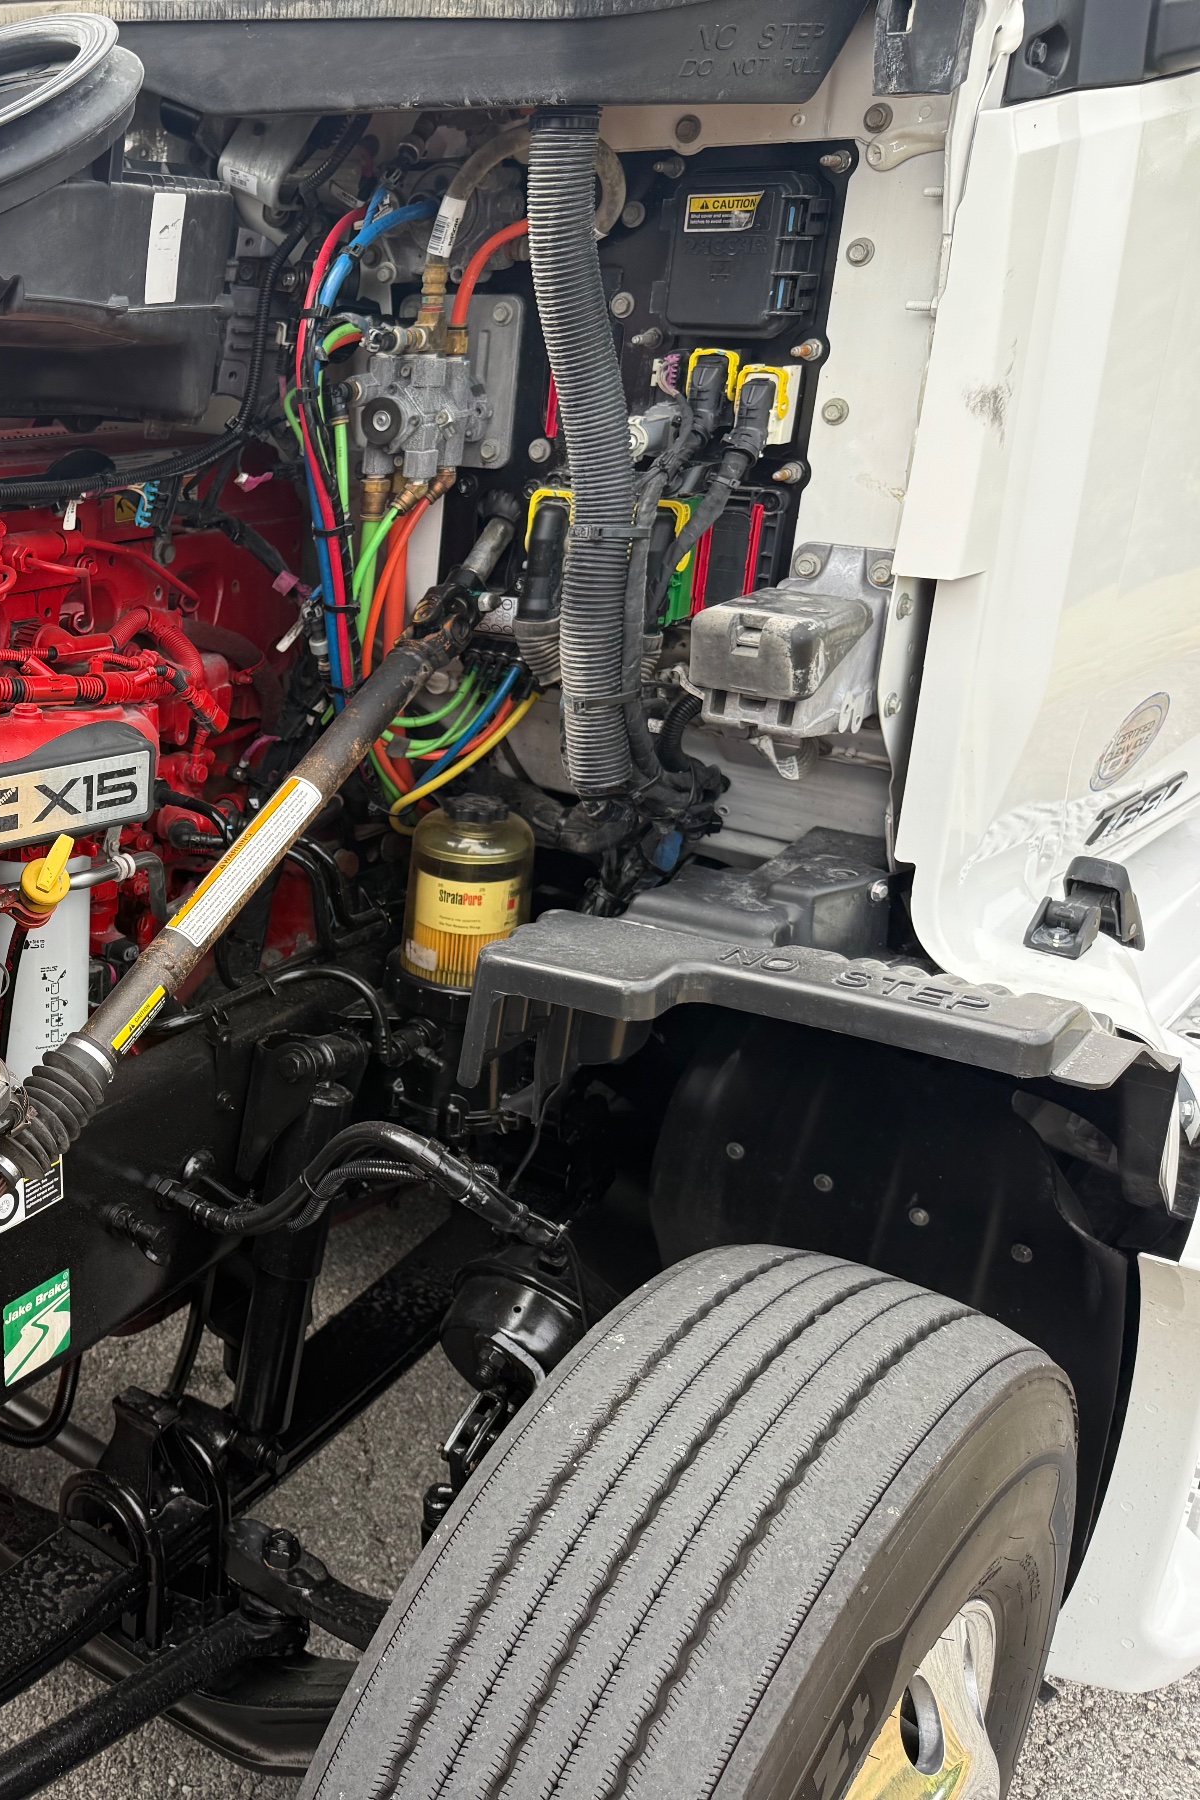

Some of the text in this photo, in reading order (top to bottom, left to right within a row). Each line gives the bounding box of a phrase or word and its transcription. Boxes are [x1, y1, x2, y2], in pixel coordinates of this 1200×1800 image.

[690, 23, 825, 50] NO STEP
[679, 59, 712, 77] DO
[712, 199, 757, 209] CAUTION
[687, 235, 767, 256] PACCAR
[32, 766, 138, 824] X15
[222, 833, 253, 867] WARNING
[438, 889, 483, 907] StrataPore
[719, 947, 992, 1010] NO STEP
[134, 1003, 151, 1023] CAUTION
[4, 1280, 68, 1325] Jake Brake
